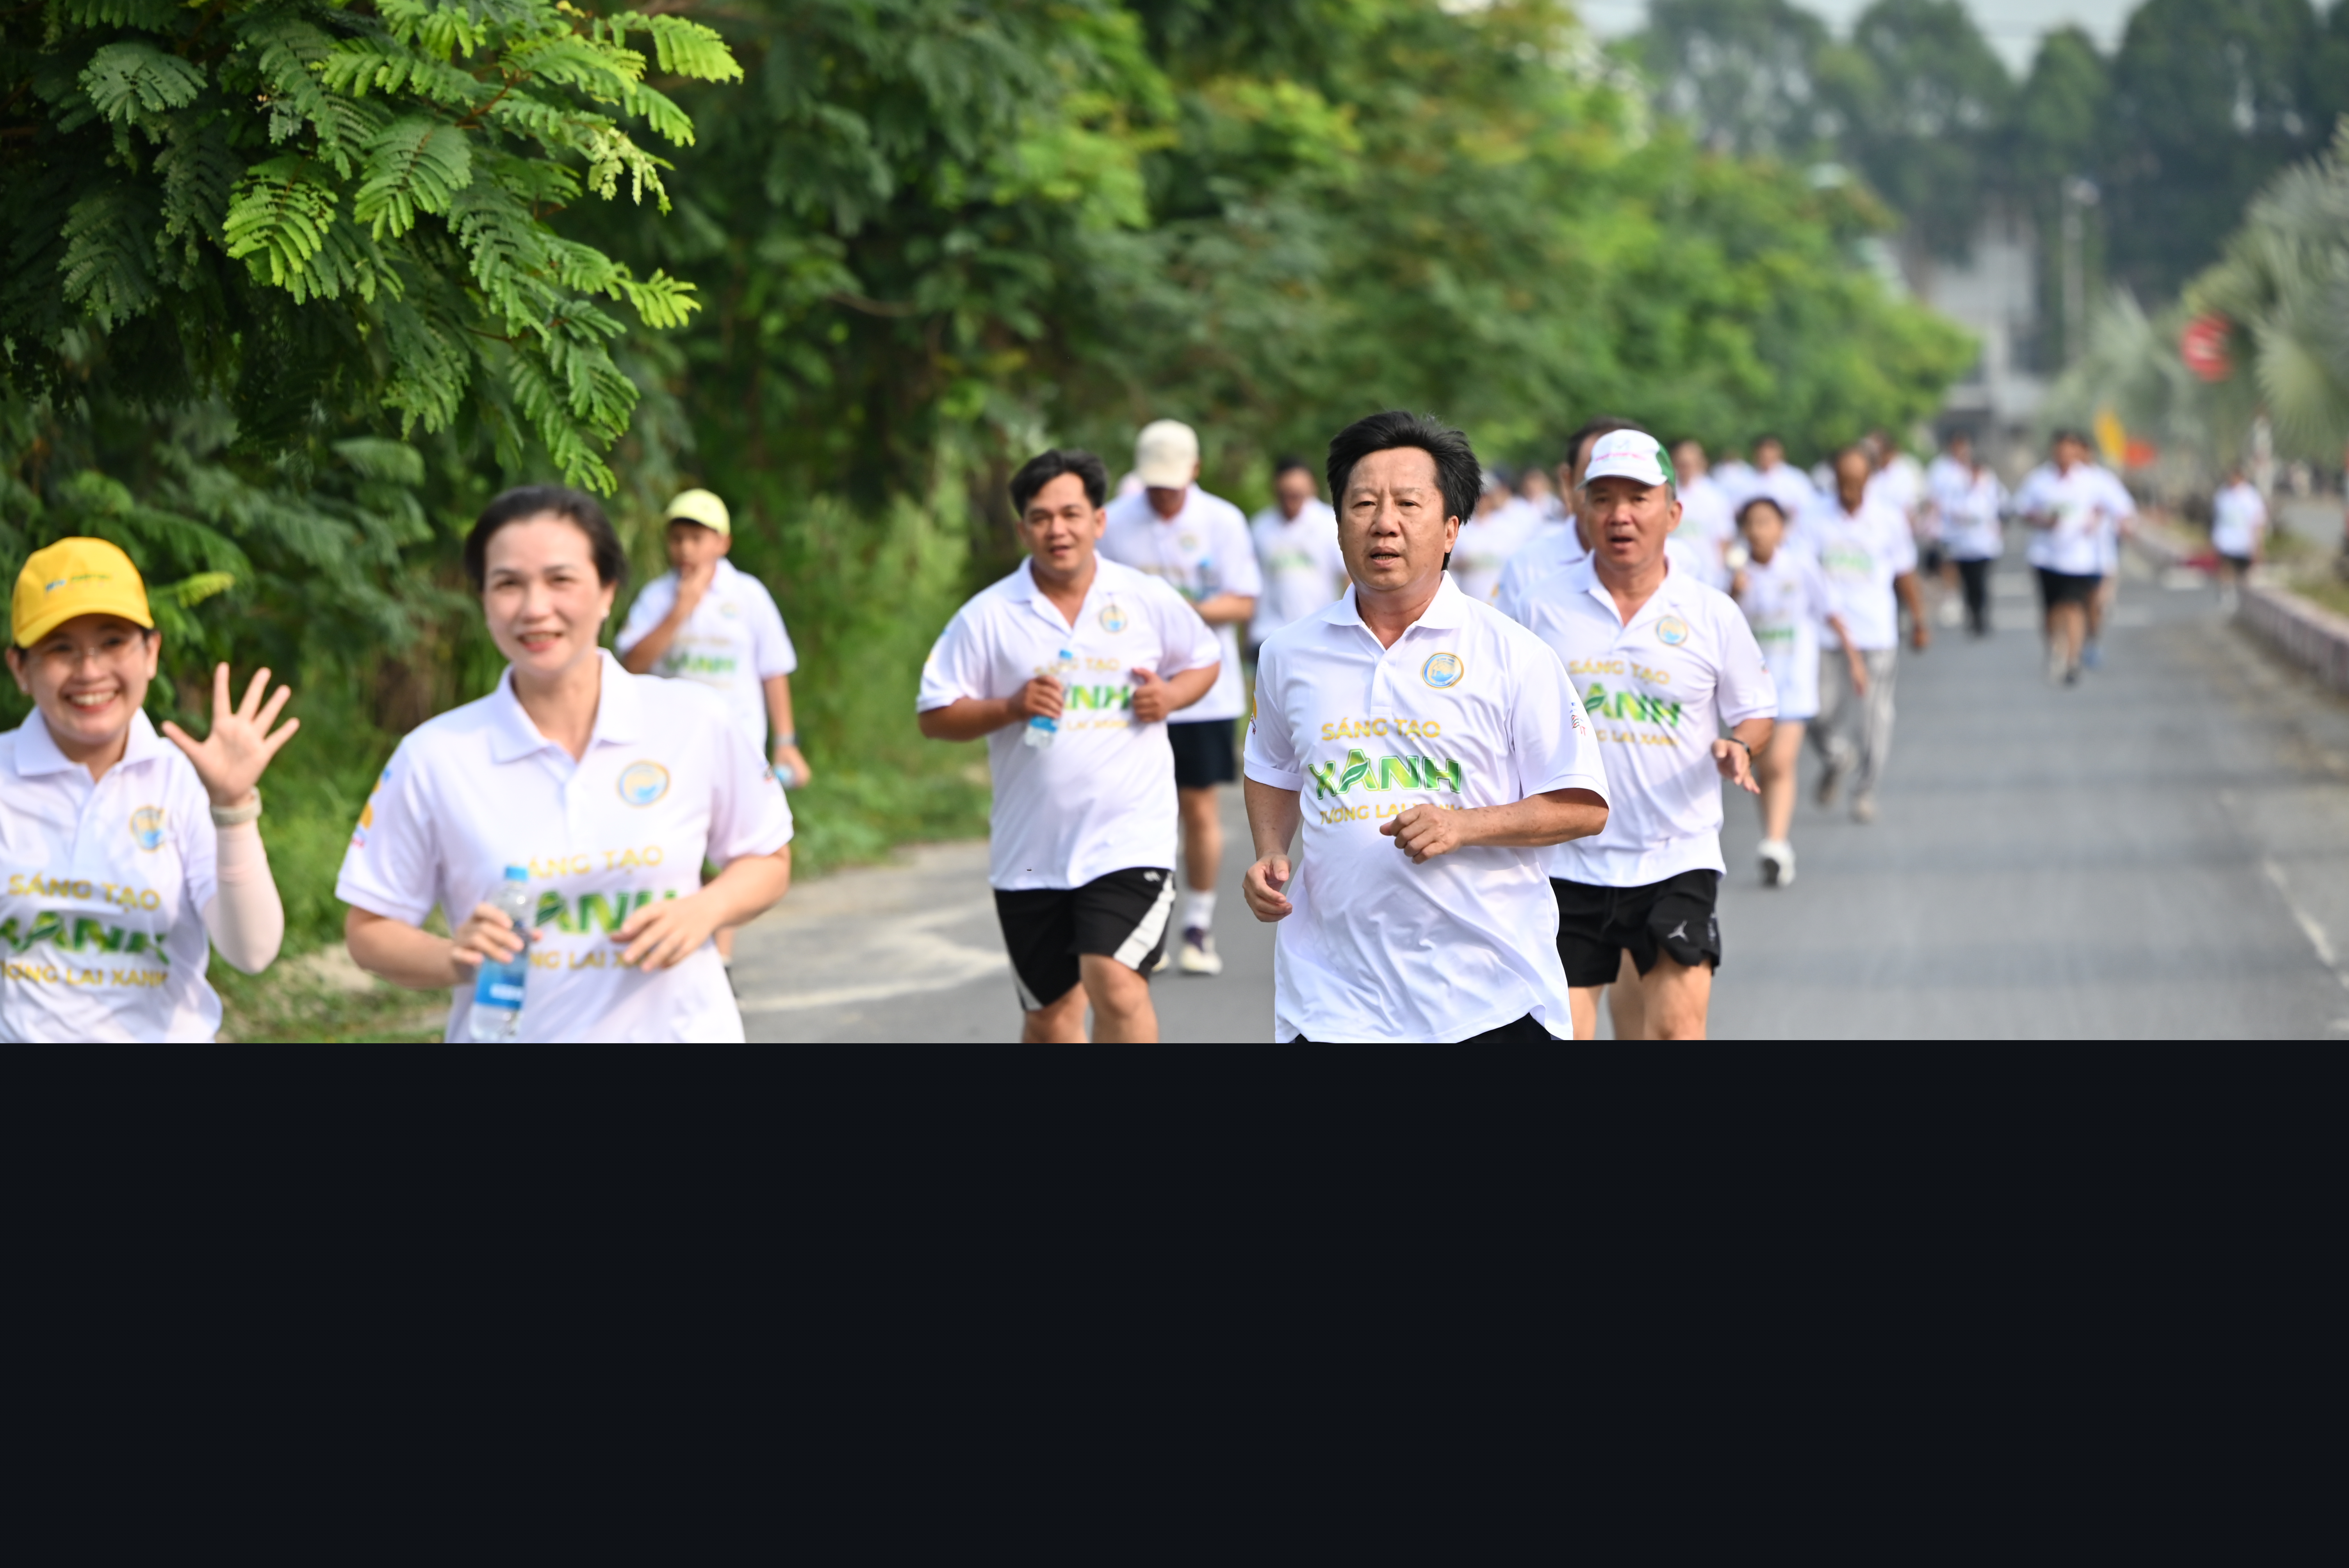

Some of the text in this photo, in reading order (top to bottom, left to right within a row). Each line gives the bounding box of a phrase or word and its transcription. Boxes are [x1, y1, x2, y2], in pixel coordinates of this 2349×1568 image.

[1568, 657, 1670, 685] SÁNG TẠO
[1065, 684, 1129, 711] NH
[1584, 682, 1681, 727] ANH
[1321, 717, 1441, 741] SÁNG TẠO
[1308, 748, 1461, 800] XANH
[529, 845, 665, 880] ÁNG TẠO
[7, 871, 161, 914] SÁNG TẠO
[569, 950, 606, 970] LAI
[66, 968, 104, 985] LAI
